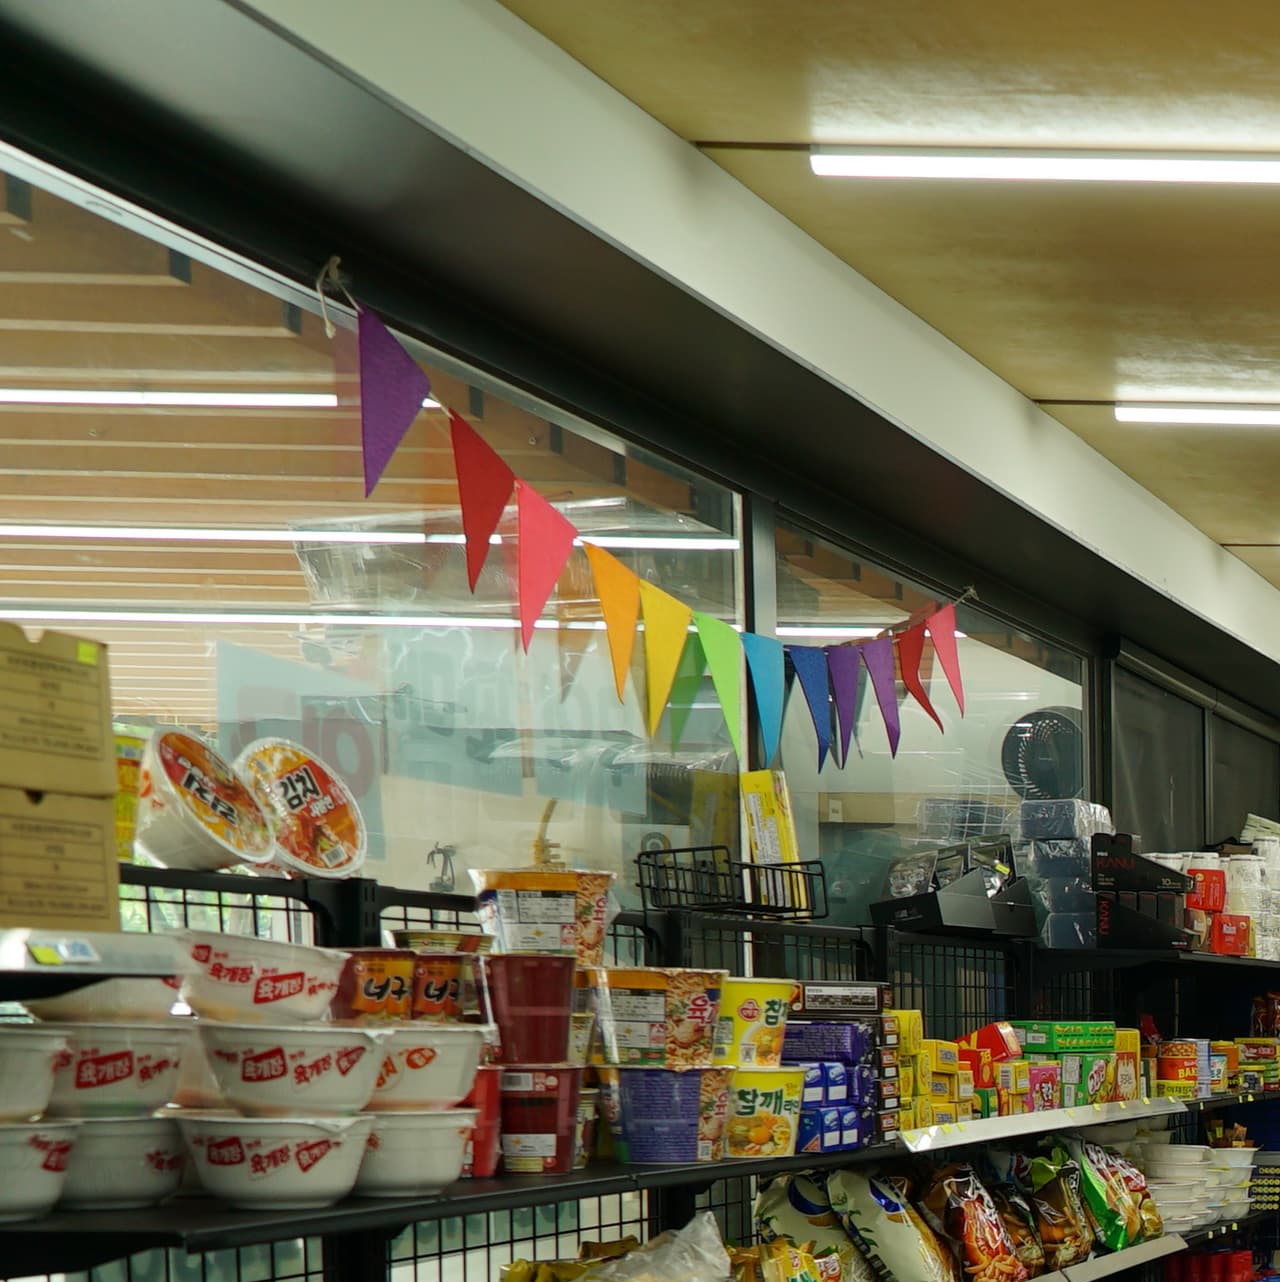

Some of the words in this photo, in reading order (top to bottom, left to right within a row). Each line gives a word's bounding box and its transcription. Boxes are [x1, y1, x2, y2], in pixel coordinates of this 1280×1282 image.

[280, 766, 321, 812] 김치
[256, 974, 302, 1001] 육개장
[244, 1055, 285, 1079] 육개장
